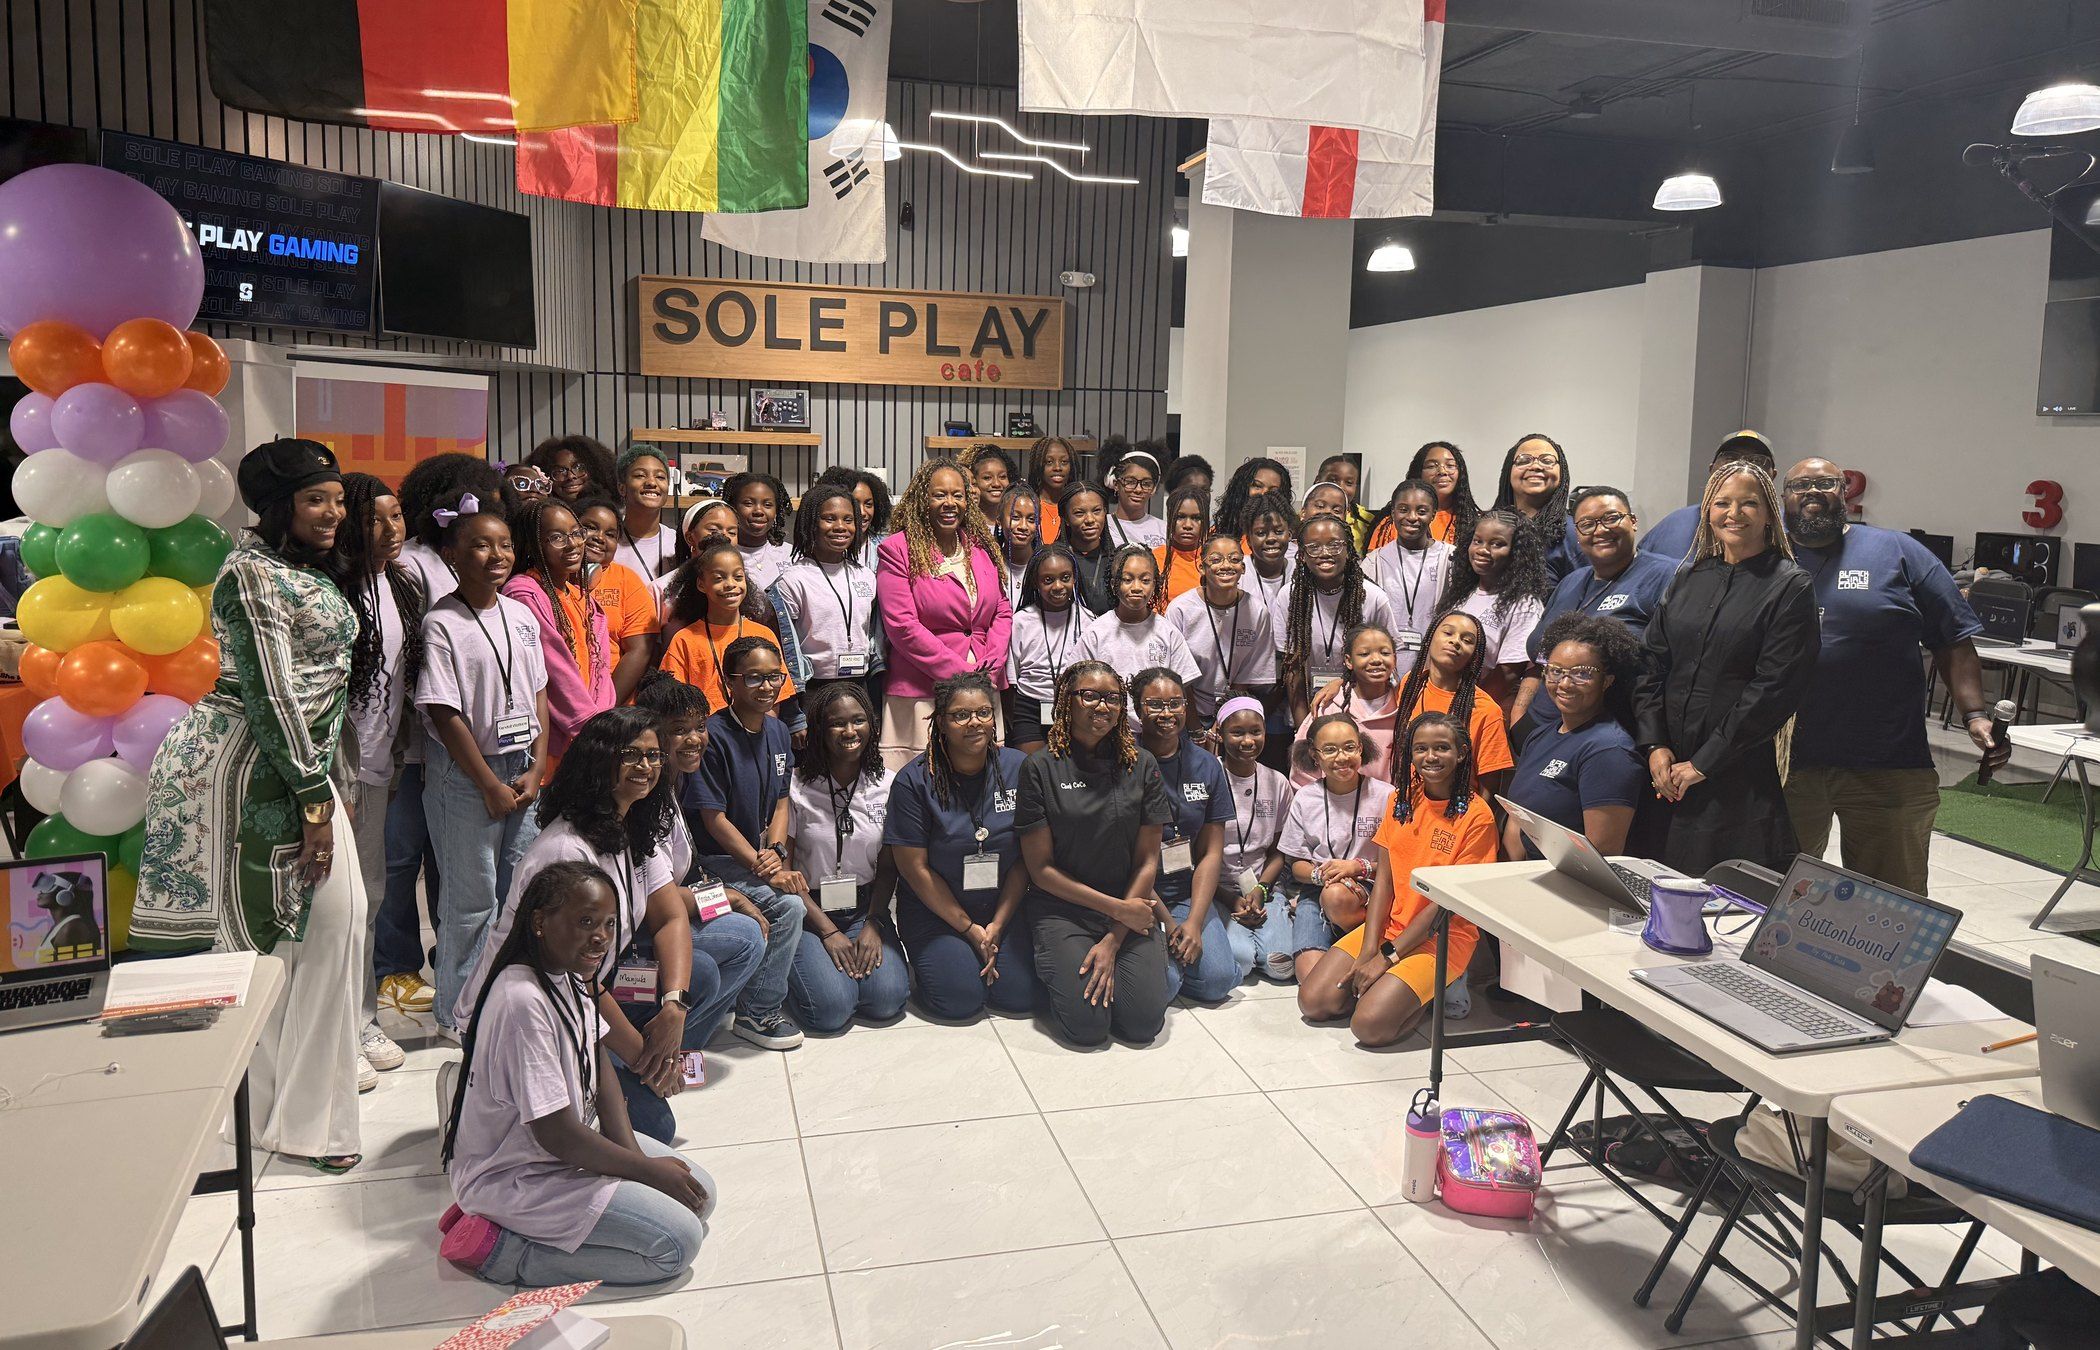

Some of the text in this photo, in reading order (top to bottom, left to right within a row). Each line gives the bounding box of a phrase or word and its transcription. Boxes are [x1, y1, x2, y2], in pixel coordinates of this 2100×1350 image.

[125, 142, 363, 198] SOLE PLAY GAMING SOLE
[183, 181, 261, 209] GAMING
[266, 195, 313, 217] SOLE
[317, 202, 361, 224] PLAY
[200, 224, 359, 264] PLAY GAMING
[652, 288, 1050, 359] SOLE PLAY
[940, 359, 1001, 382] cafe
[2022, 480, 2064, 529] 3
[1839, 570, 1869, 578] BLACK
[1798, 909, 1901, 962] Buttonbound
[2050, 1033, 2078, 1049] acer
